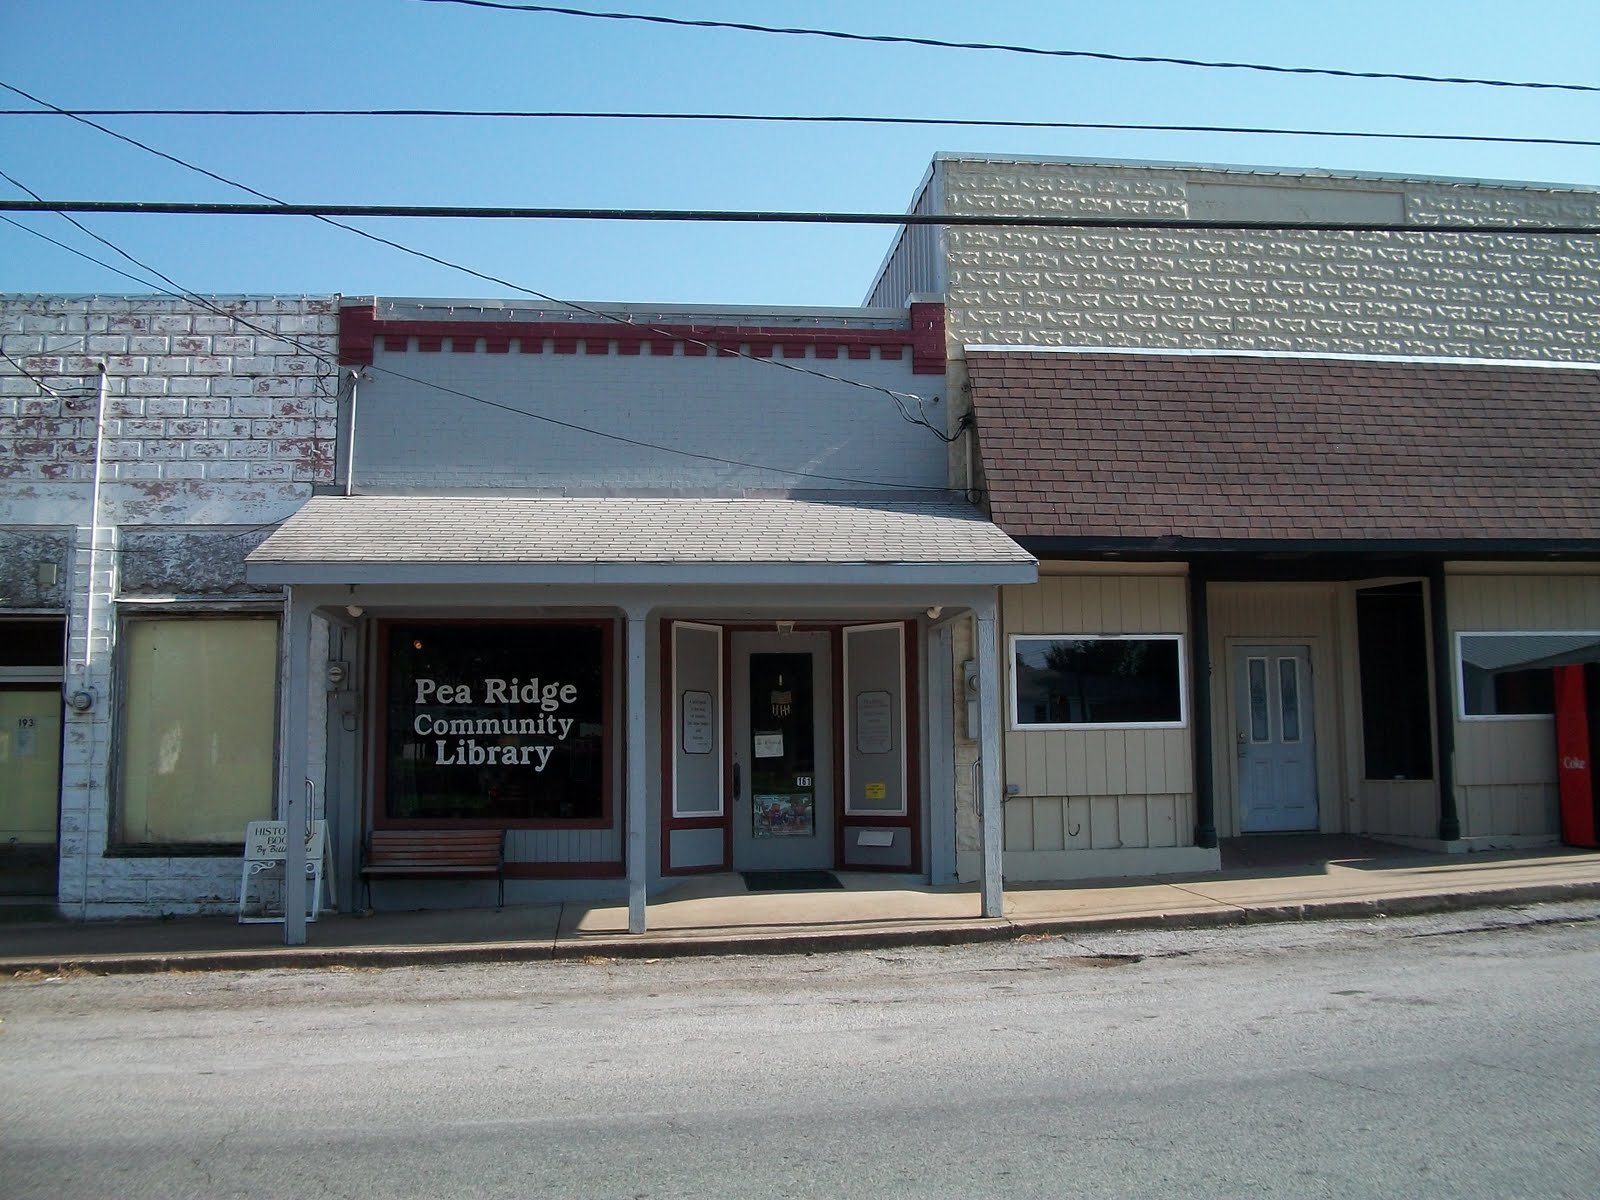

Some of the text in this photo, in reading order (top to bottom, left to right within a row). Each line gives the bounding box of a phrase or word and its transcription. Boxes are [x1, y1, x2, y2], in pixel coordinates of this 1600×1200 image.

[415, 677, 578, 712] Pea Ridge
[18, 718, 34, 727] 193
[414, 713, 574, 740] Community
[435, 739, 554, 772] Library
[1563, 756, 1586, 769] Coke
[798, 777, 811, 786] 161
[256, 845, 267, 855] By
